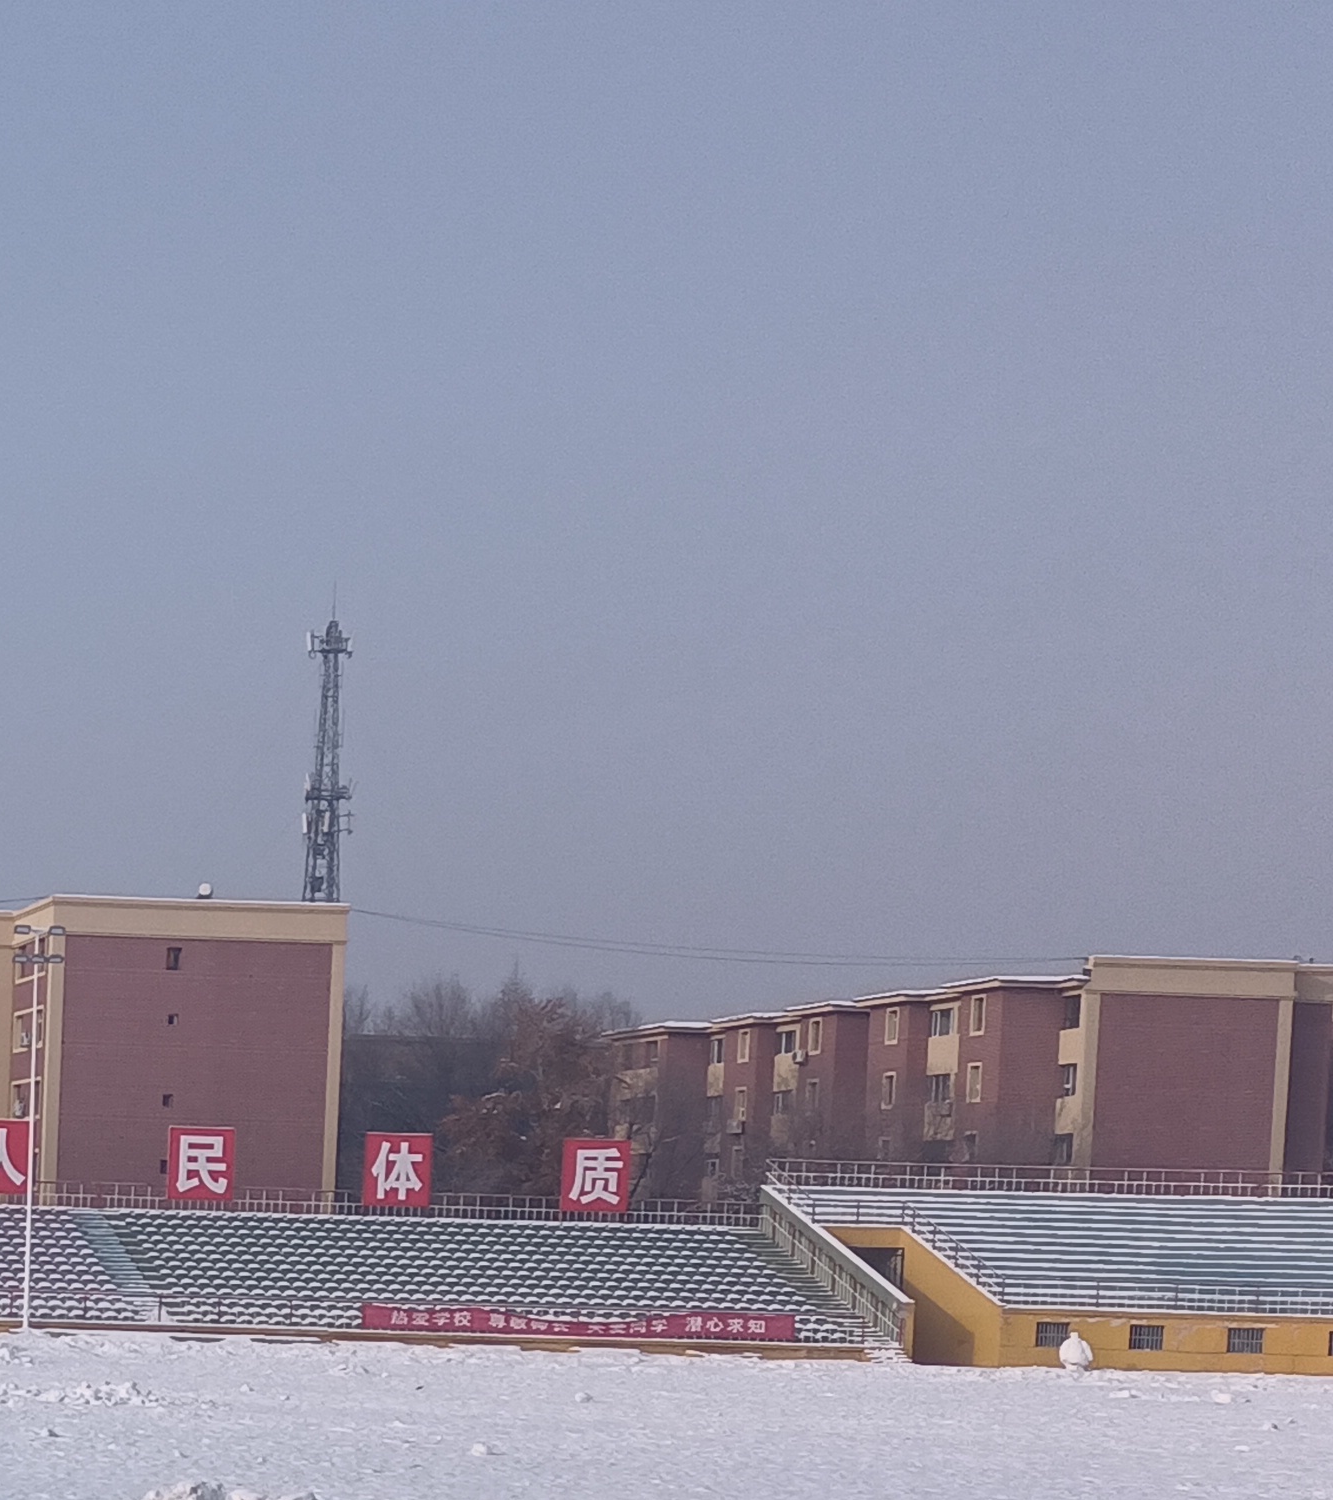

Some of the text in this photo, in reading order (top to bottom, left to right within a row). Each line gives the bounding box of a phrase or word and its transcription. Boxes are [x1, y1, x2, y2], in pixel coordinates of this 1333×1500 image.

[174, 1134, 229, 1196] 民
[369, 1140, 425, 1201] 体
[567, 1146, 625, 1207] 质
[390, 1309, 472, 1327] 热爱学校
[685, 1315, 766, 1334] 潜心求知
